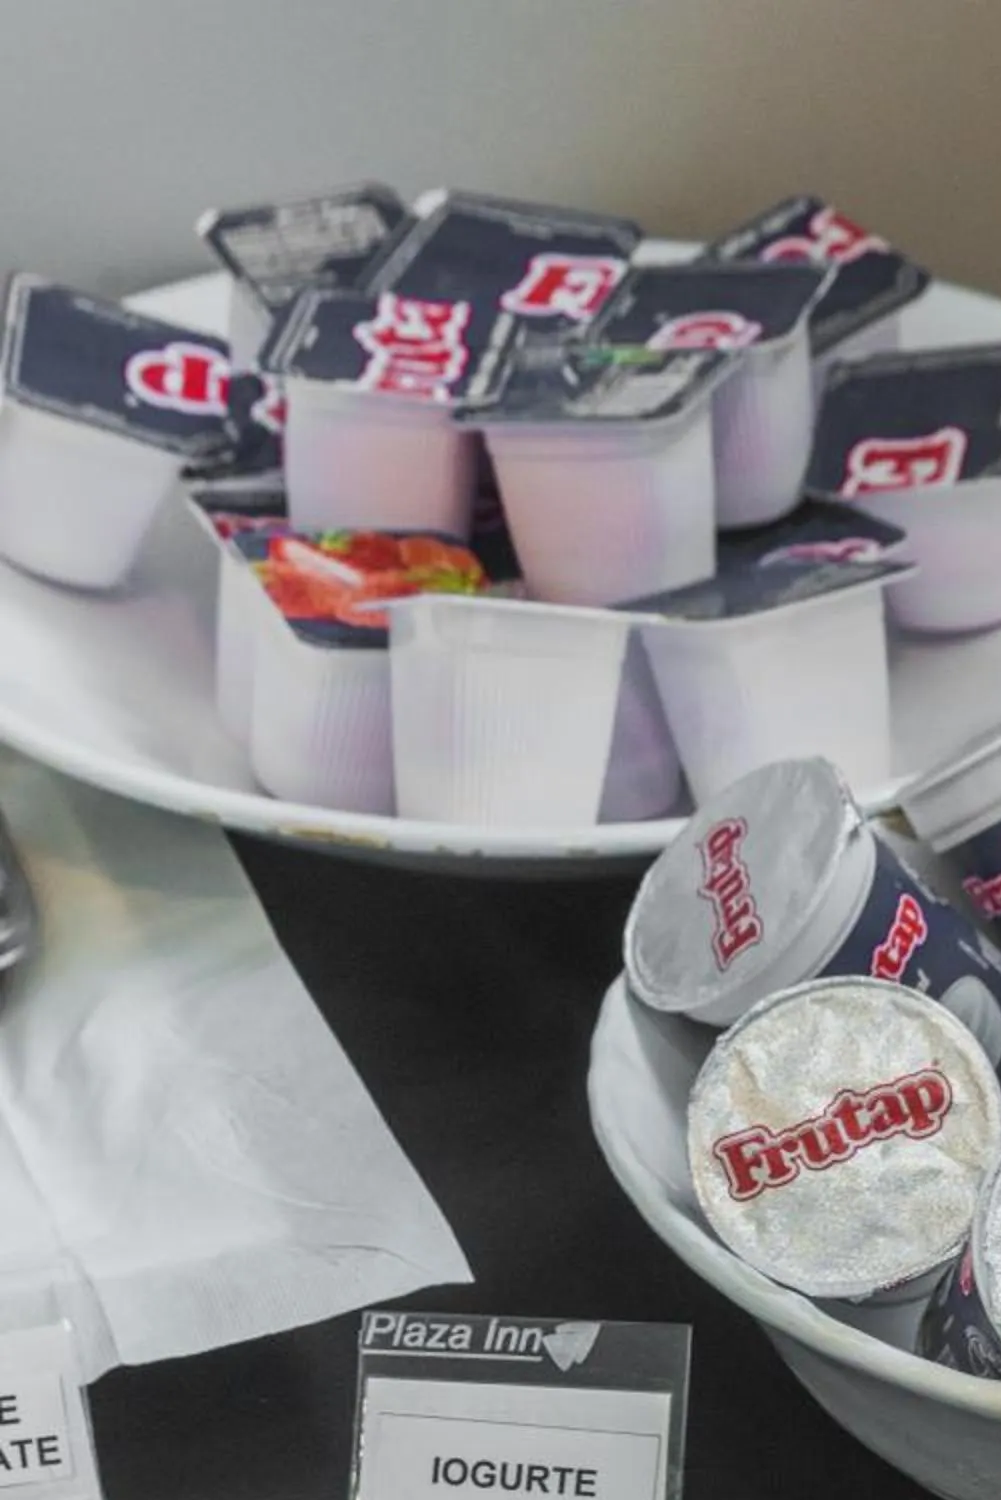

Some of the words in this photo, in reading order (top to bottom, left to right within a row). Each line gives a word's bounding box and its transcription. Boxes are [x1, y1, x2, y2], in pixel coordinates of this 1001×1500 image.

[698, 817, 762, 971] Frutap
[713, 1069, 954, 1202] Frutap
[364, 1313, 472, 1353] Plaza
[484, 1320, 543, 1354] Inn
[431, 1456, 598, 1498] IOGURTE
